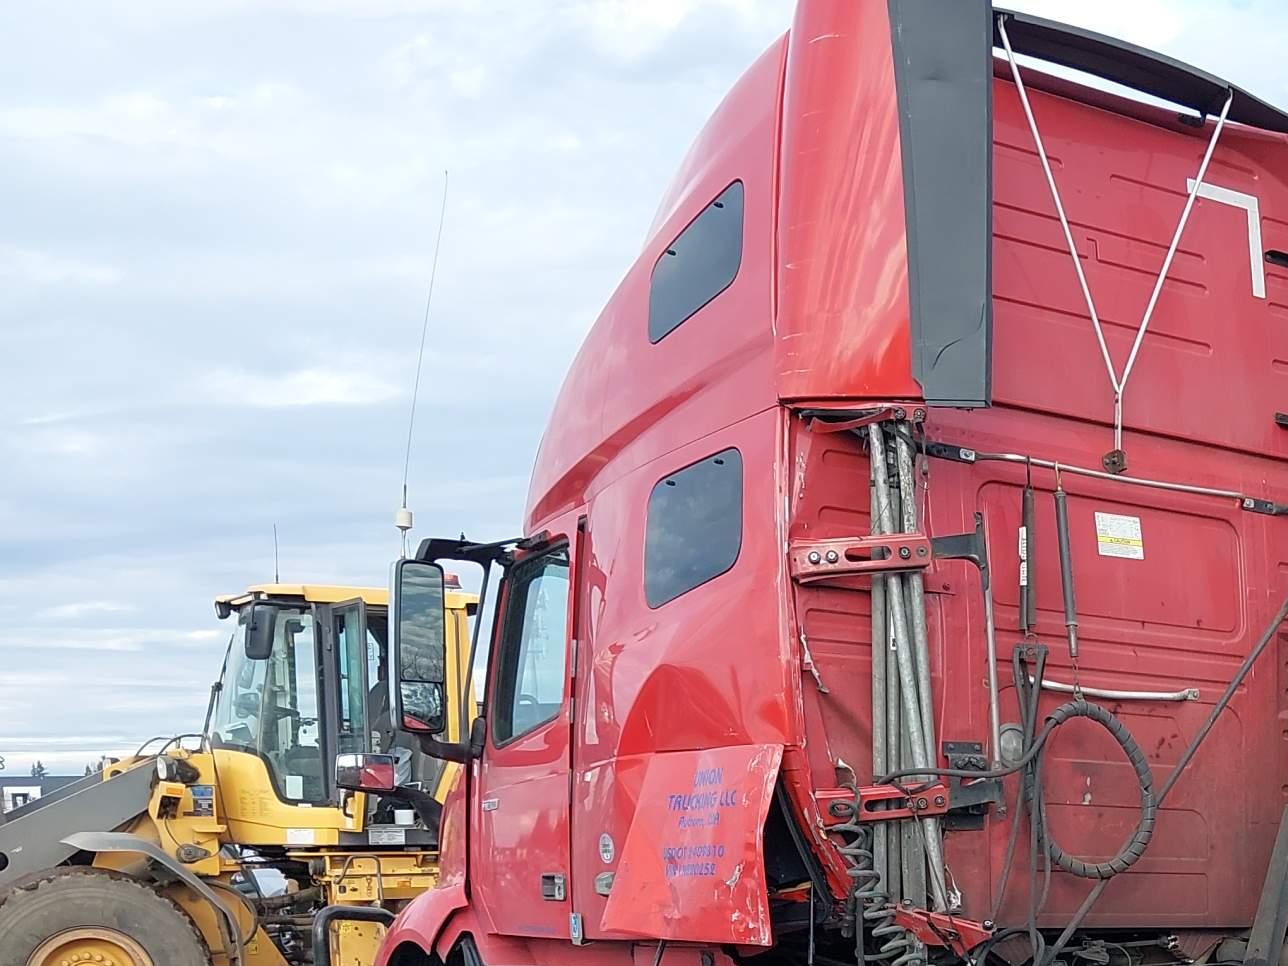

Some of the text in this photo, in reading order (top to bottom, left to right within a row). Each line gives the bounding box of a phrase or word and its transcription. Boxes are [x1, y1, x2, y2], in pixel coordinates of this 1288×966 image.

[694, 768, 724, 787] UNION
[668, 789, 737, 811] TRUCKING LLC
